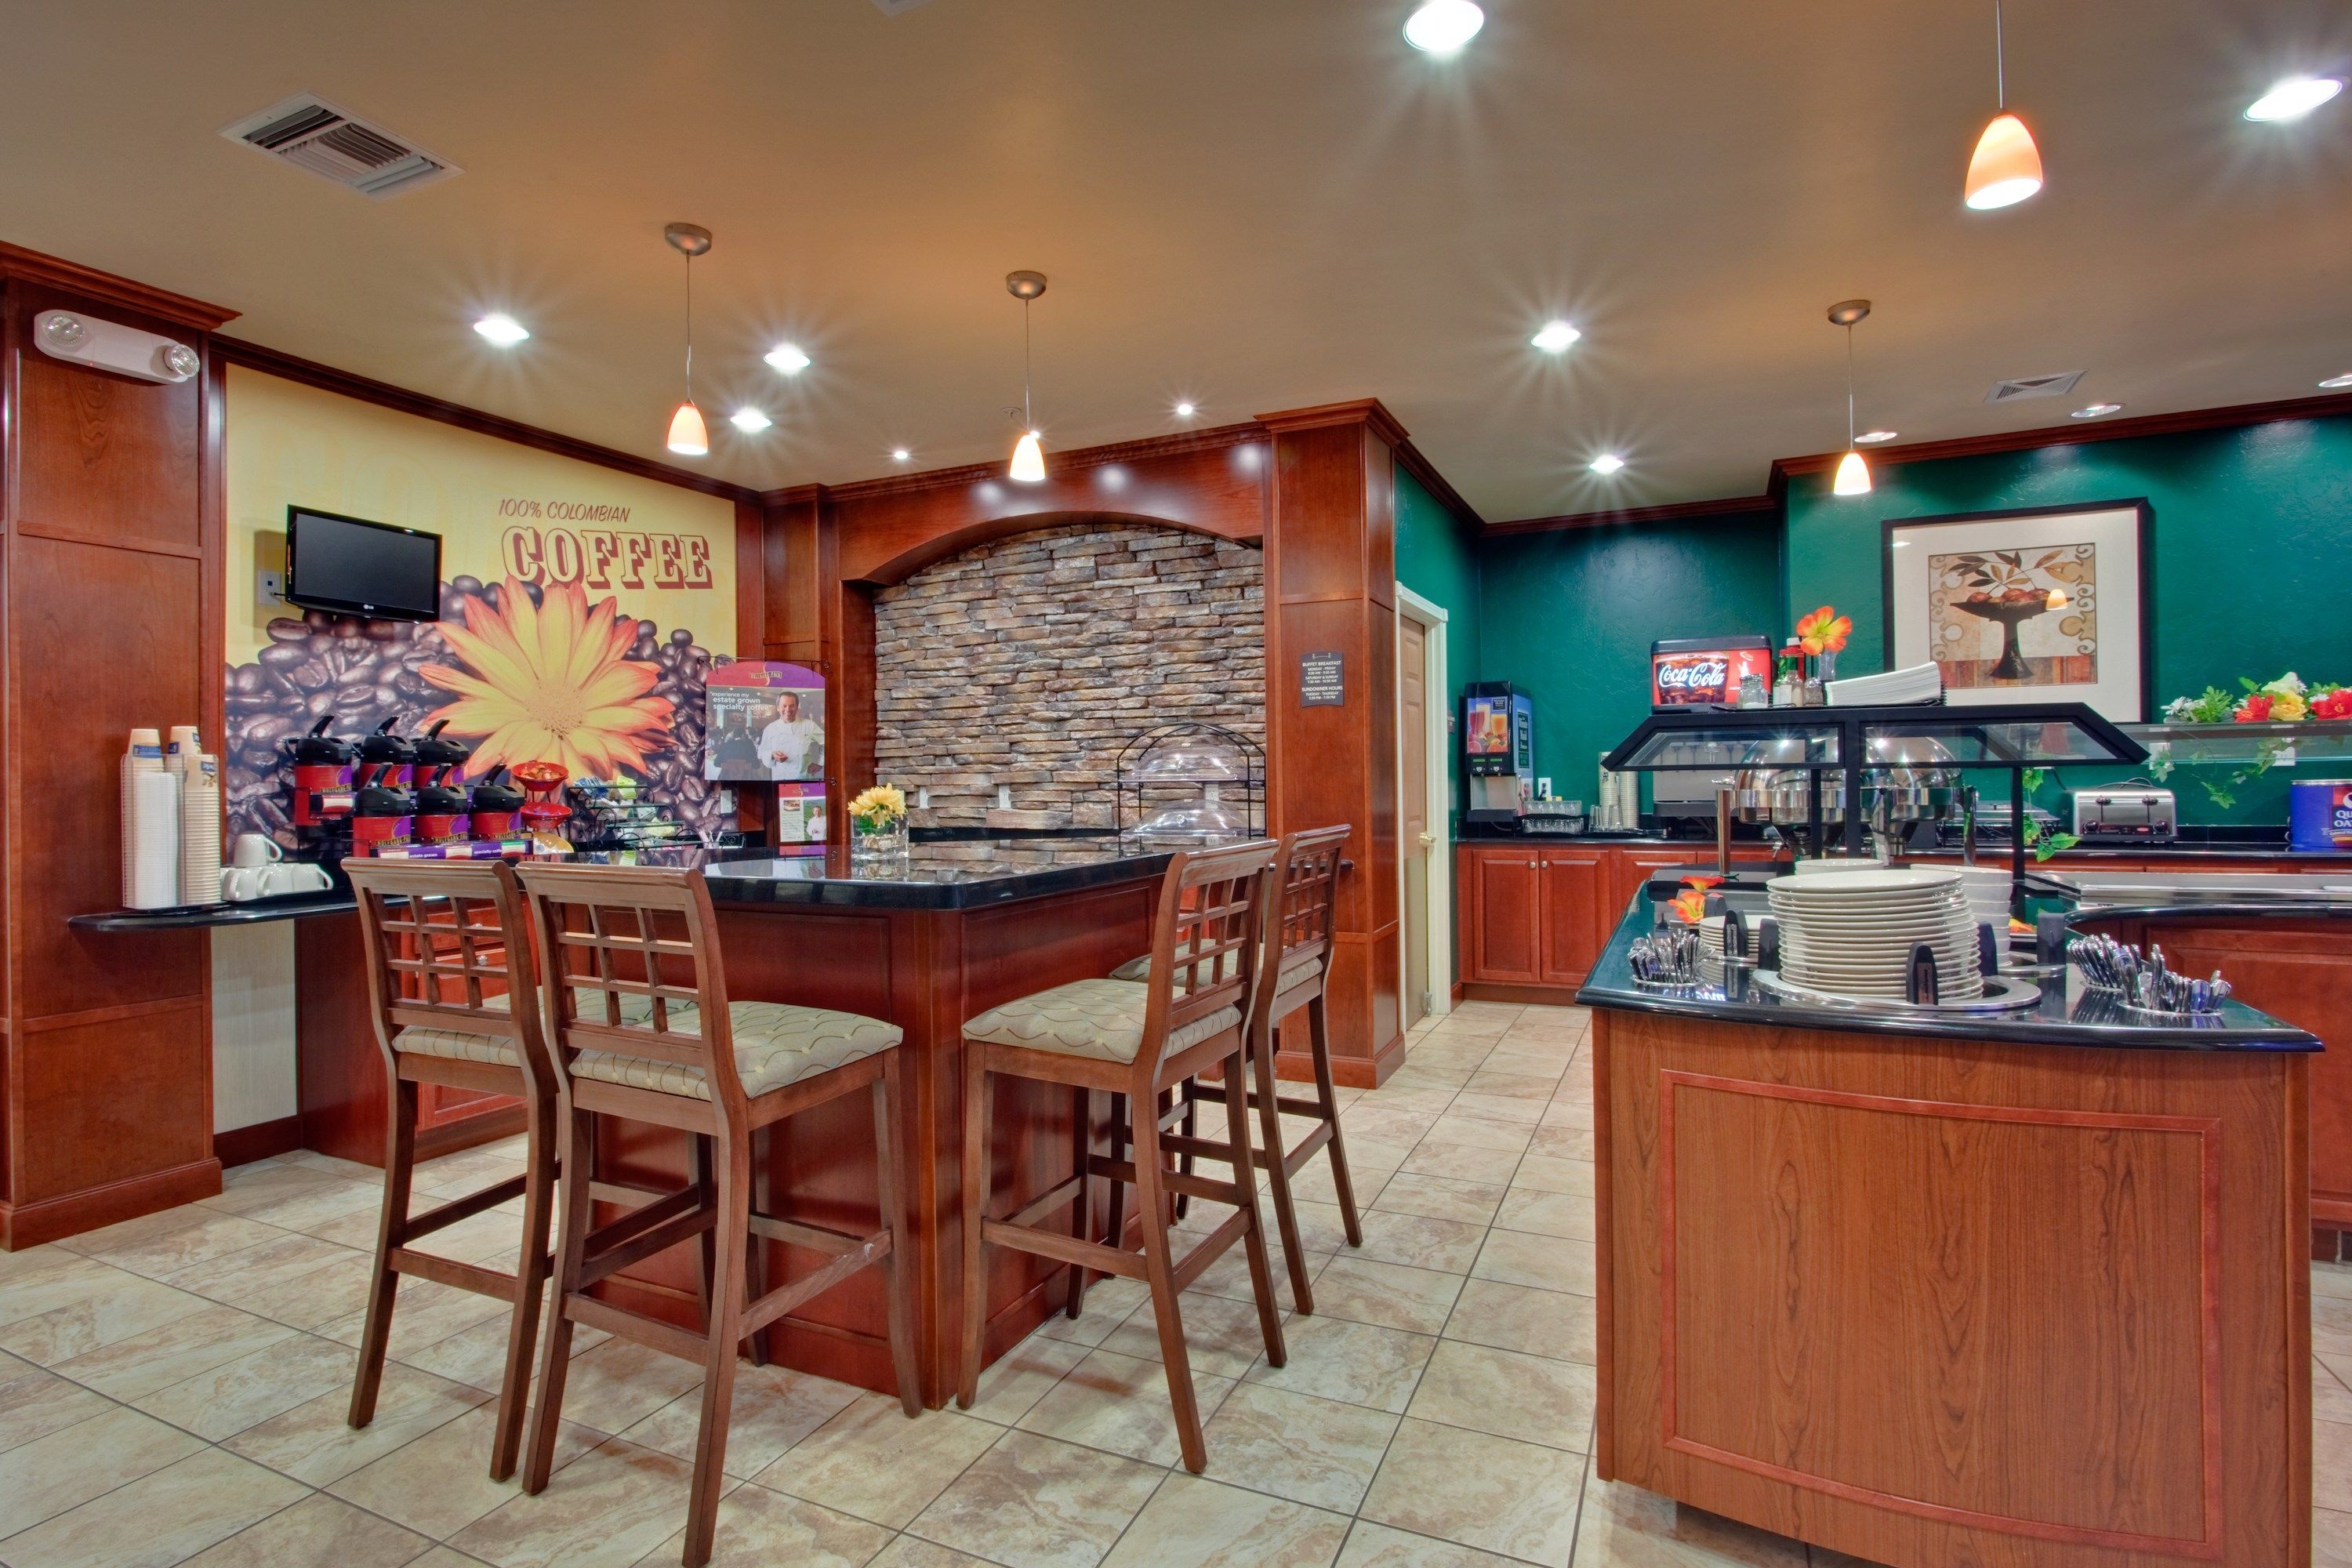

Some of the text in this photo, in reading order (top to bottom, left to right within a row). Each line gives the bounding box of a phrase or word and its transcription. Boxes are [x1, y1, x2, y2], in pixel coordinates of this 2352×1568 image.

[499, 499, 631, 523] 100% COLOMBIAN
[502, 525, 713, 589] COFFEE
[1658, 662, 1726, 688] Coca-Cola
